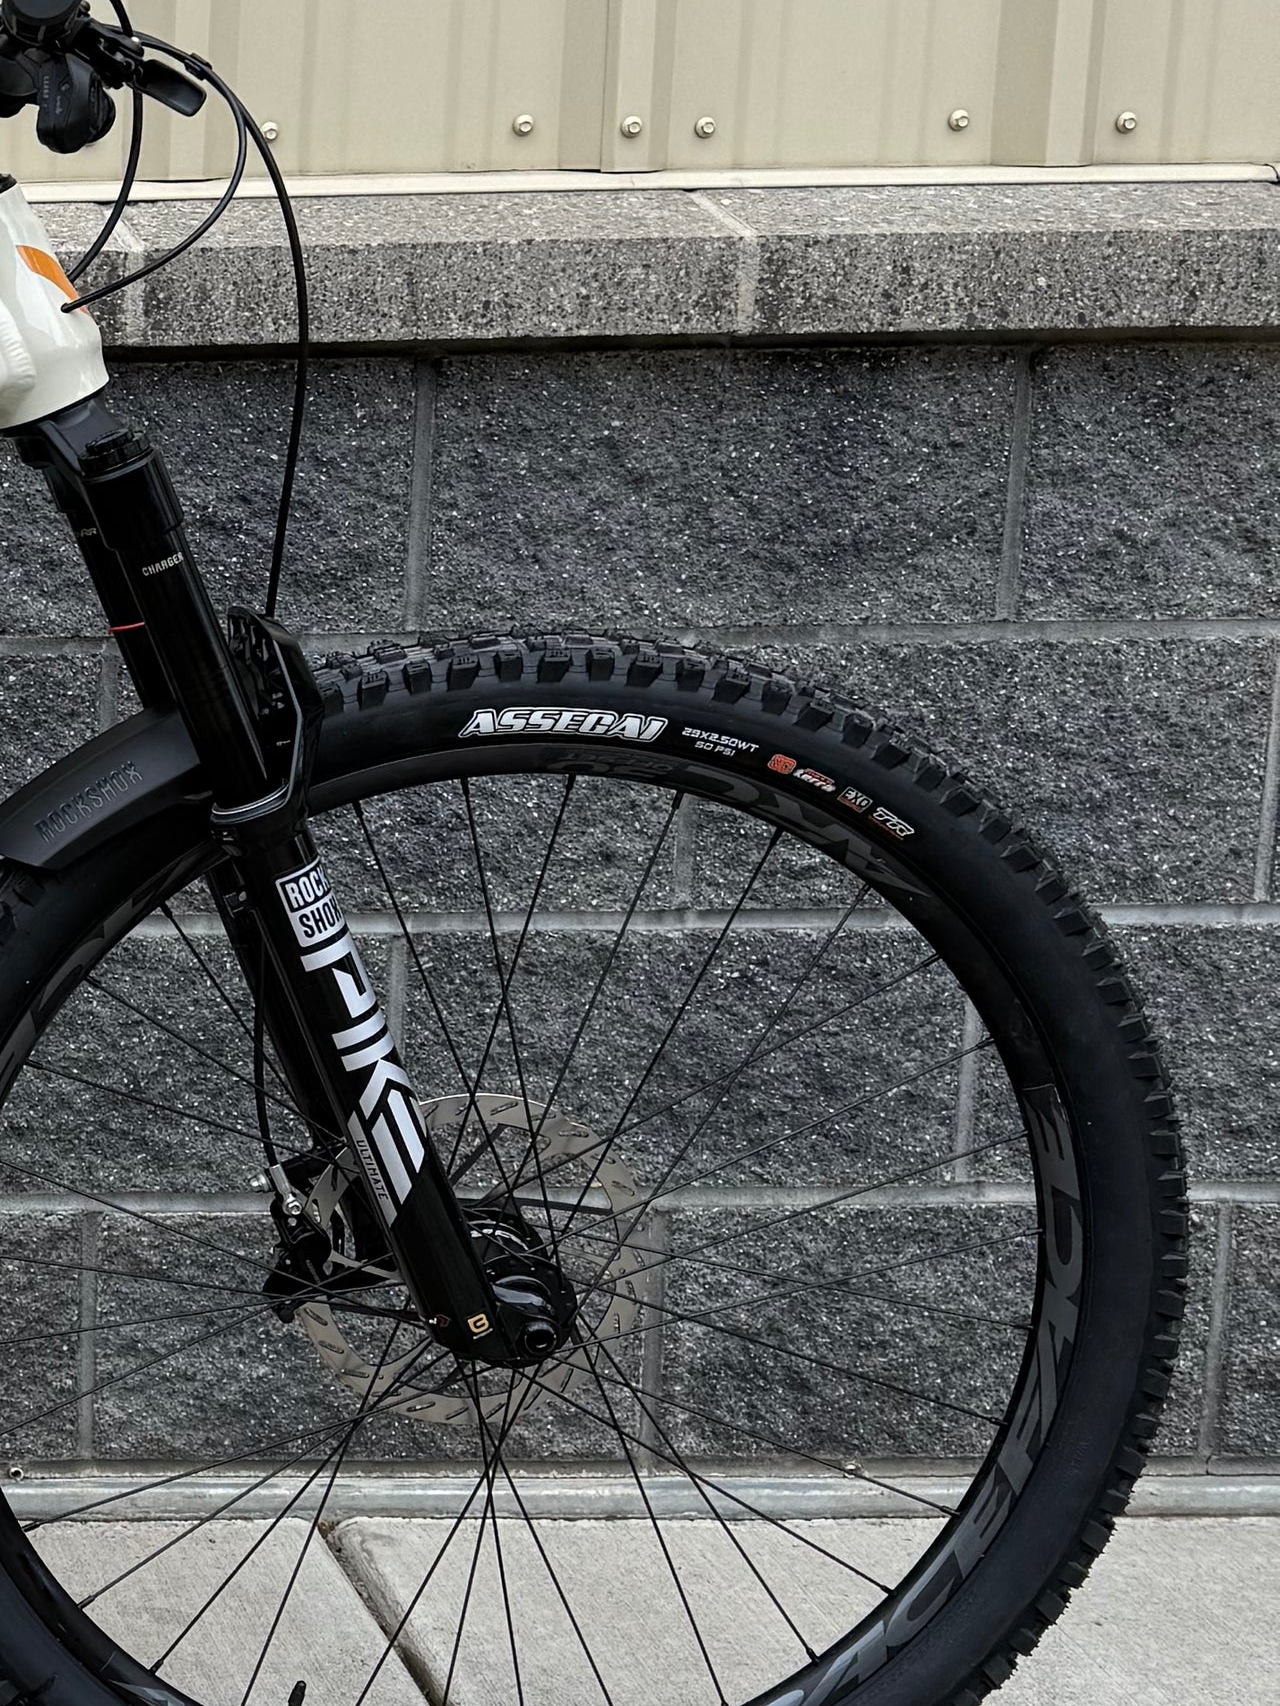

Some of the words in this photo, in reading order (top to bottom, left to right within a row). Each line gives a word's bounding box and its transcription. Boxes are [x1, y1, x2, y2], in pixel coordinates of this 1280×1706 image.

[141, 551, 185, 577] CHARGER
[457, 705, 669, 744] ASSEGAI
[715, 745, 736, 758] PSI
[33, 760, 144, 844] ROCKSHOX
[841, 787, 873, 810] EXO
[871, 805, 916, 838] TR
[284, 863, 331, 910] ROCK
[298, 895, 343, 939] SHOX
[300, 934, 428, 1228] PIKE
[355, 1139, 389, 1201] ULTIMATE
